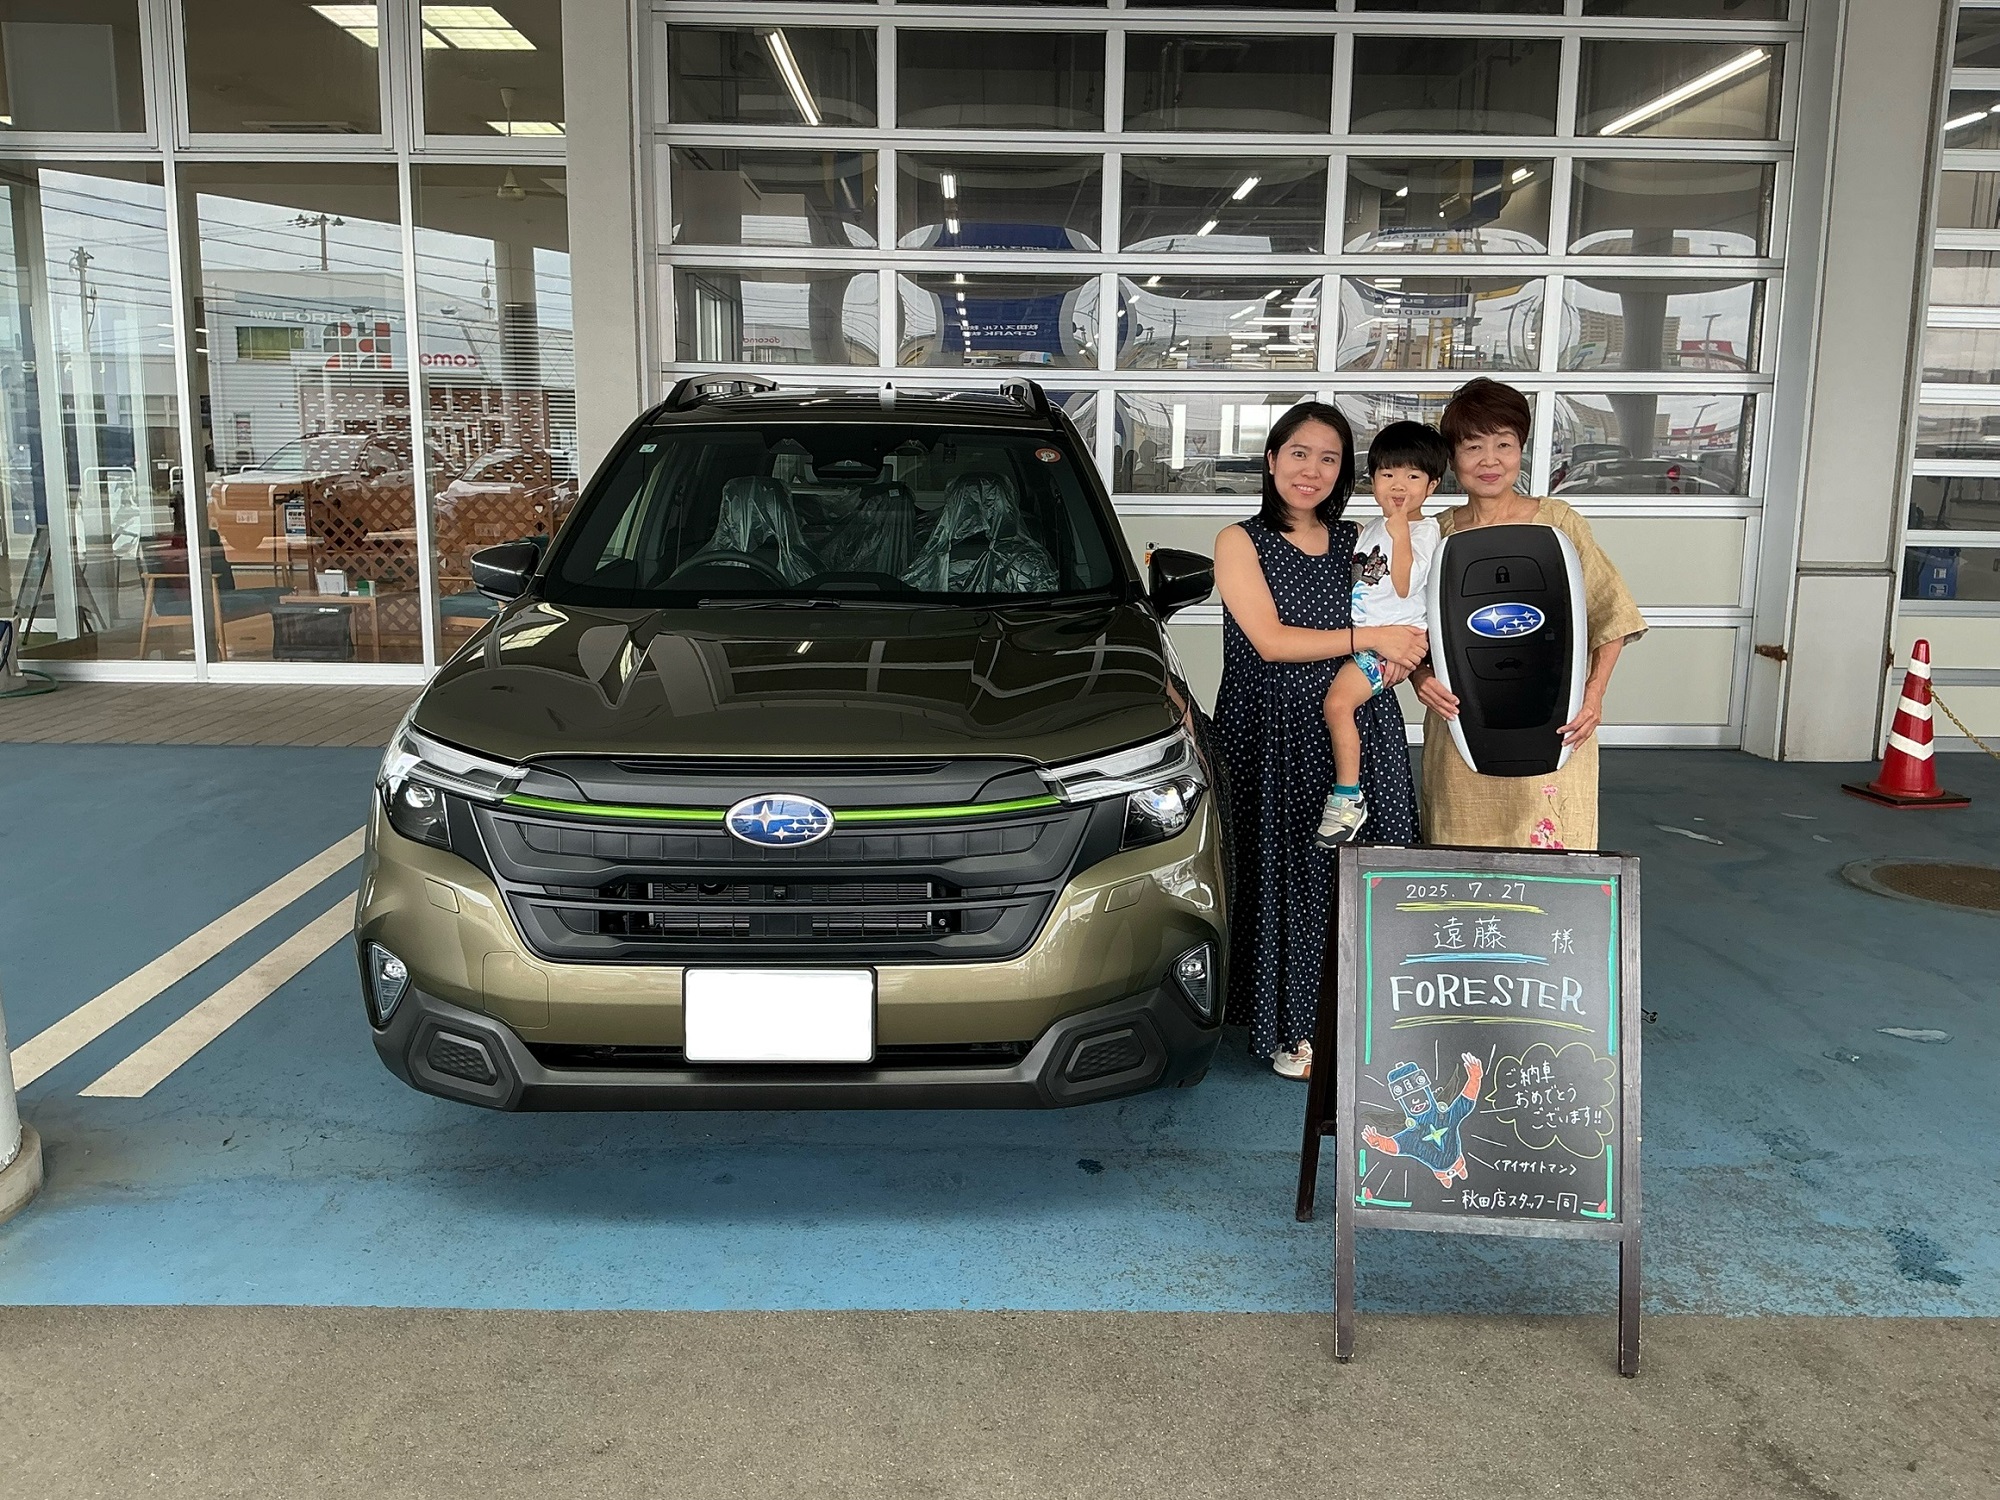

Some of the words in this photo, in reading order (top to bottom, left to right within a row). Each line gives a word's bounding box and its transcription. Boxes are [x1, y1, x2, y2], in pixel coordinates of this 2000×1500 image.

[282, 310, 400, 324] FORESTER
[1501, 882, 1526, 902] 27
[1432, 914, 1507, 949] 遠藤
[1551, 928, 1576, 955] 様
[1505, 1060, 1556, 1089] ご納車
[1514, 1082, 1577, 1109] おめでとう
